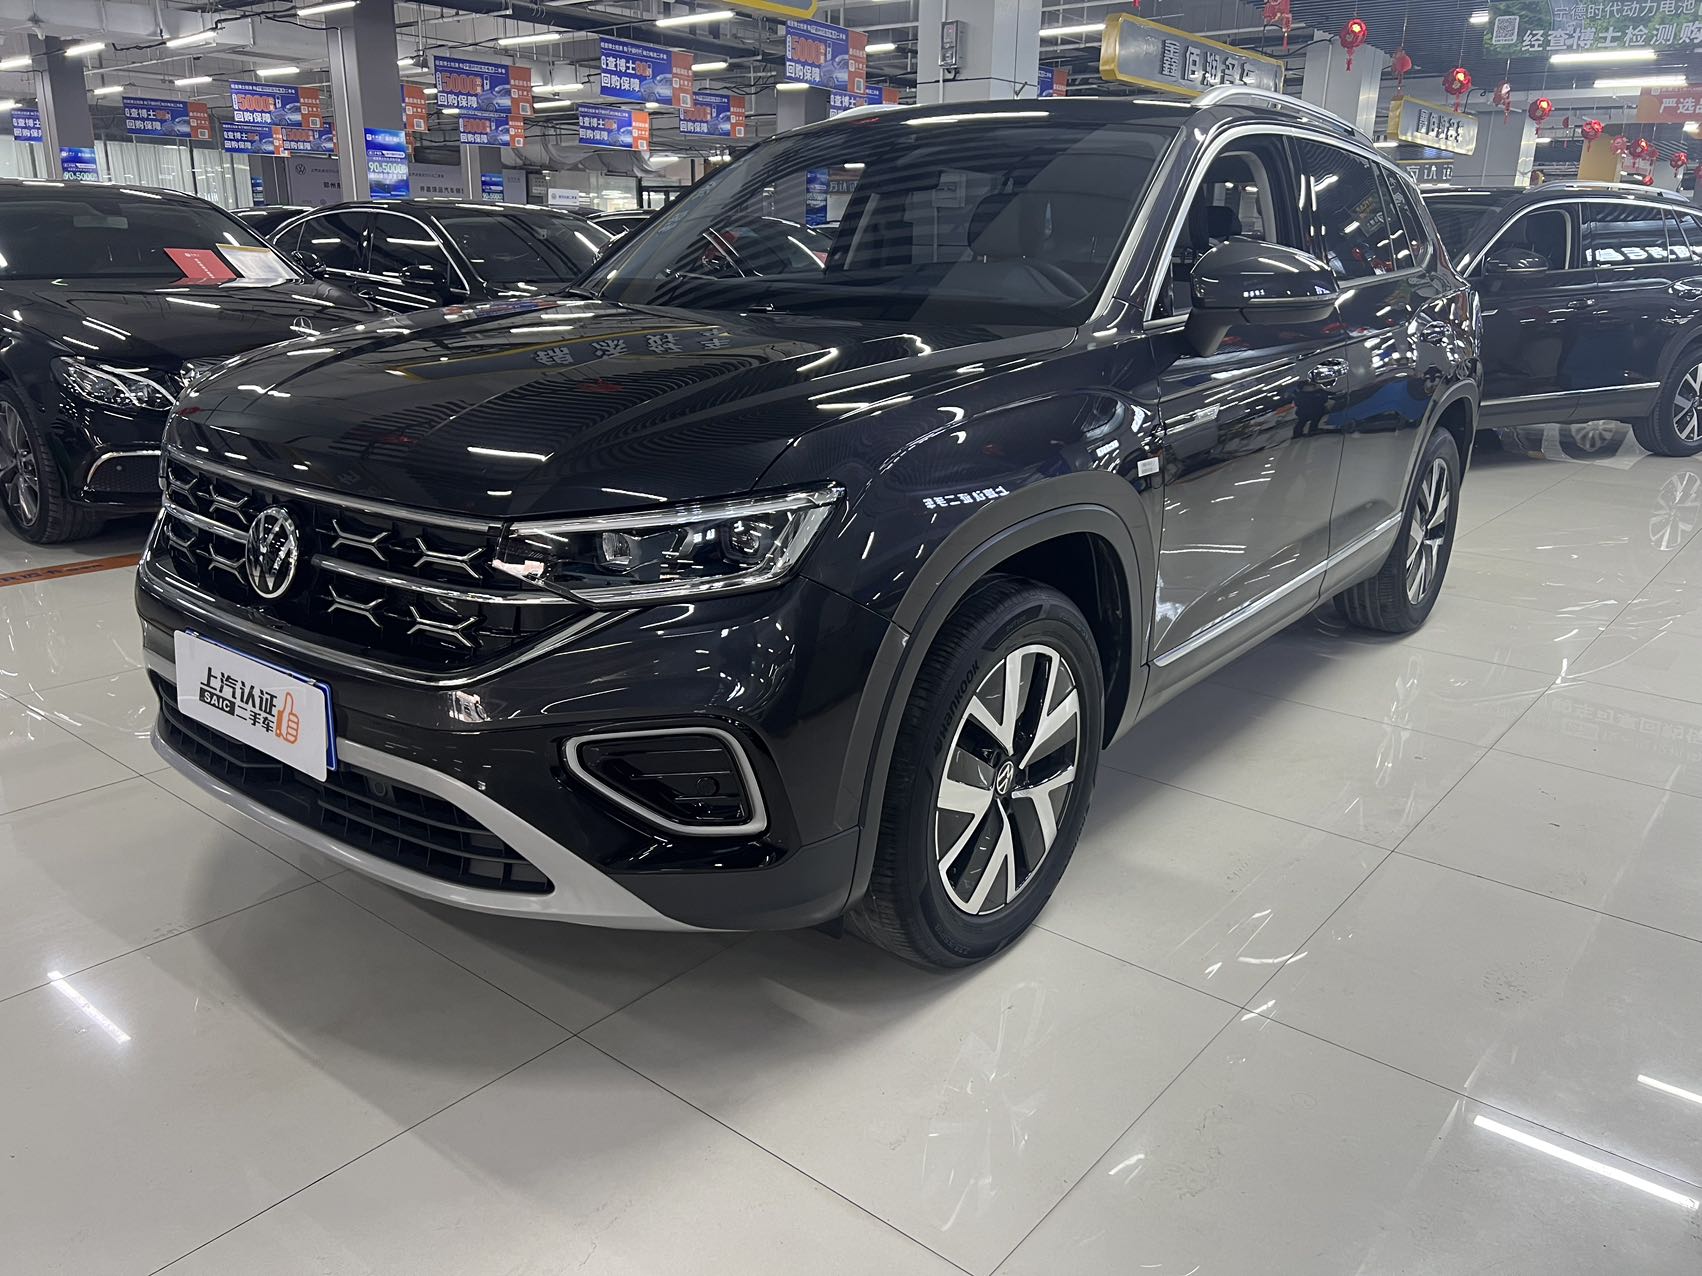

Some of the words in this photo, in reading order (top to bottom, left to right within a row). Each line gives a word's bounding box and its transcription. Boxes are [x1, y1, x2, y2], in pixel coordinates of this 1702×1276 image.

[1554, 0, 1695, 21] 宁德时代动力电池
[1521, 21, 1702, 52] 经查博士检测购
[786, 62, 822, 82] 回购保障
[601, 73, 640, 92] 回购保障
[437, 93, 478, 108] 回购保障
[234, 111, 272, 123] 回购保障
[126, 120, 162, 130] 回购保障
[680, 121, 708, 133] 回购保障
[460, 133, 488, 143] 回购保障
[579, 128, 608, 140] 回购保障
[224, 140, 252, 149] 回购保障
[283, 141, 311, 150] 回购保障
[200, 666, 278, 717] 上汽认证
[203, 691, 231, 712] SAIC
[236, 704, 275, 733] 二手车
